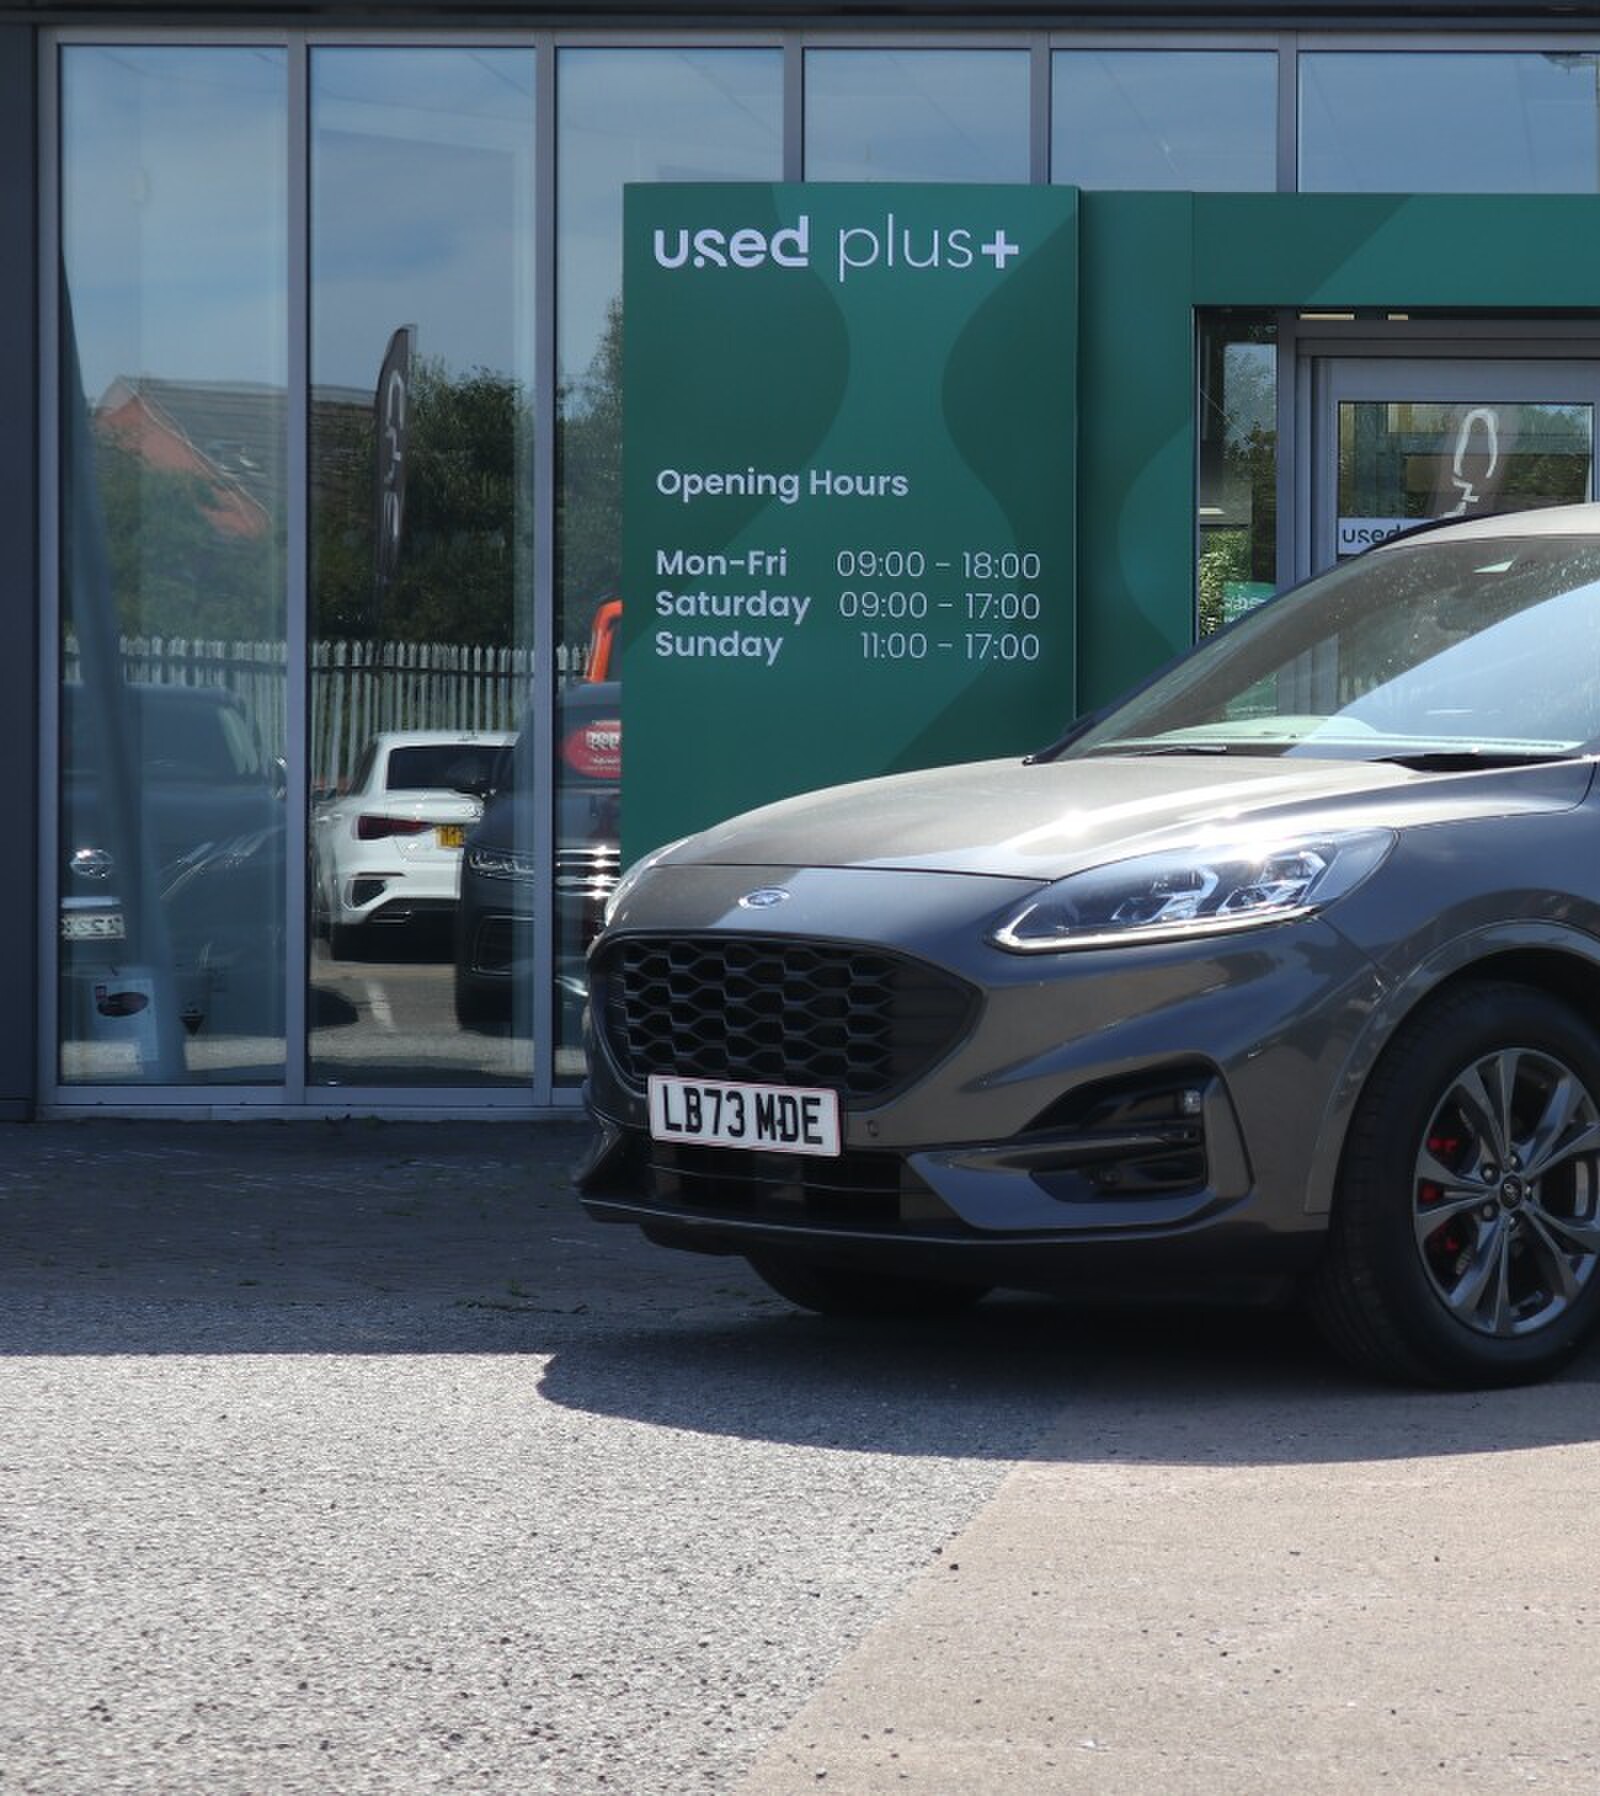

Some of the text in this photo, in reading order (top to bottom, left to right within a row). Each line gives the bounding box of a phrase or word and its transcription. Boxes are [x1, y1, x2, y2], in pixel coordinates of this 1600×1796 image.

[654, 213, 1019, 282] used plus+
[656, 467, 909, 503] Opening Hours
[656, 548, 788, 577] Mon-Fri
[836, 550, 926, 577] 09:00
[962, 551, 1041, 580] 18:00
[655, 589, 812, 625] Saturday
[839, 591, 928, 619] 09:00
[965, 592, 1041, 620] 17:00
[655, 630, 783, 667] Sunday
[861, 632, 928, 659] 11:00
[965, 633, 1041, 661] 17:00
[662, 1085, 823, 1145] LB73 MDE
